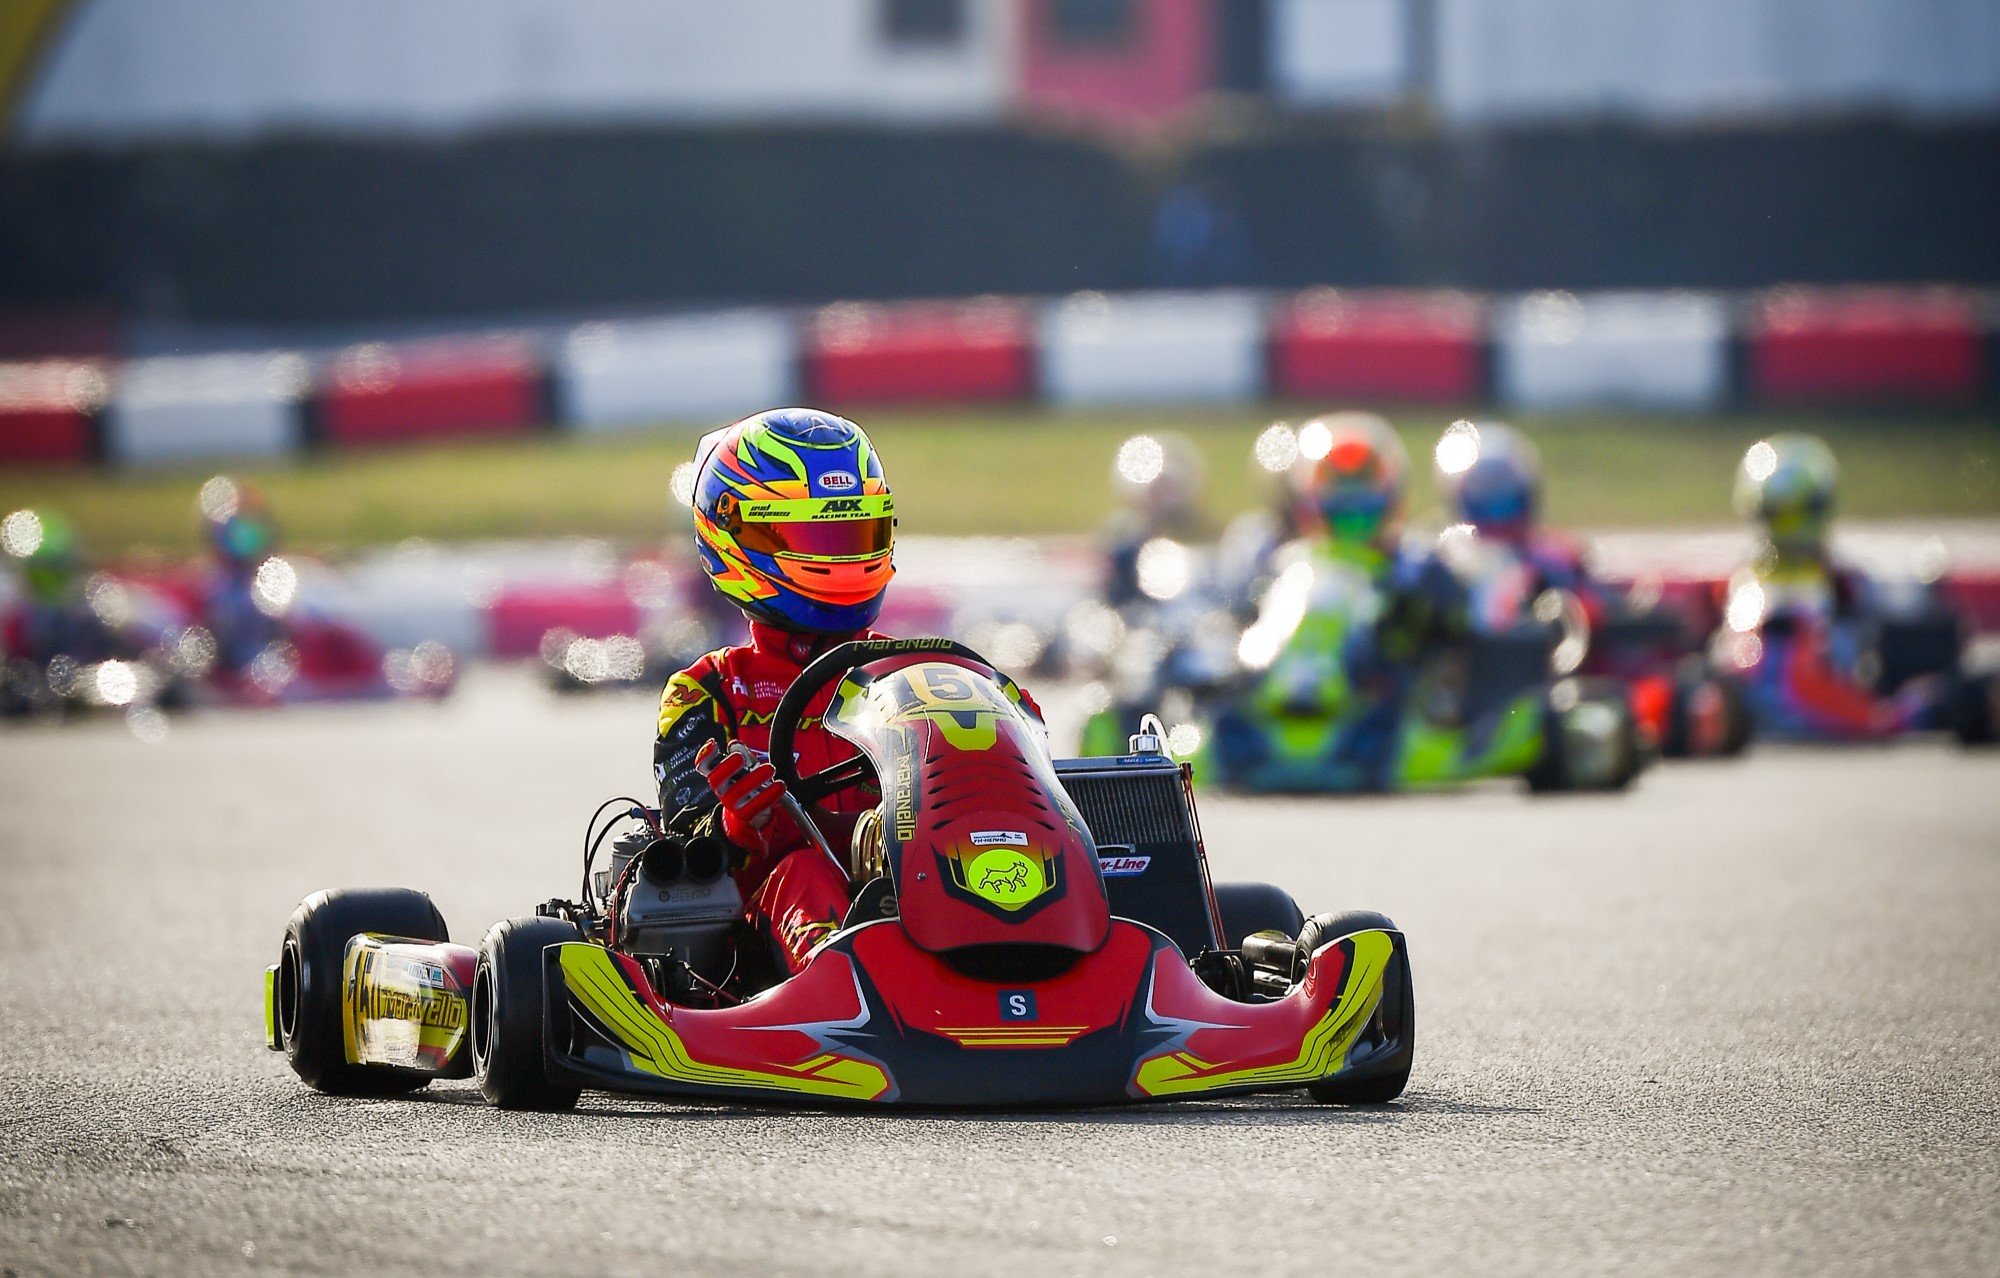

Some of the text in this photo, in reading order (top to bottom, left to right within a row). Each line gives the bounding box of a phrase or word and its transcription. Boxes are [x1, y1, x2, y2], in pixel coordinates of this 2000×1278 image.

[823, 476, 852, 486] BELL
[1100, 859, 1146, 870] w-Line
[1009, 994, 1027, 1016] S
